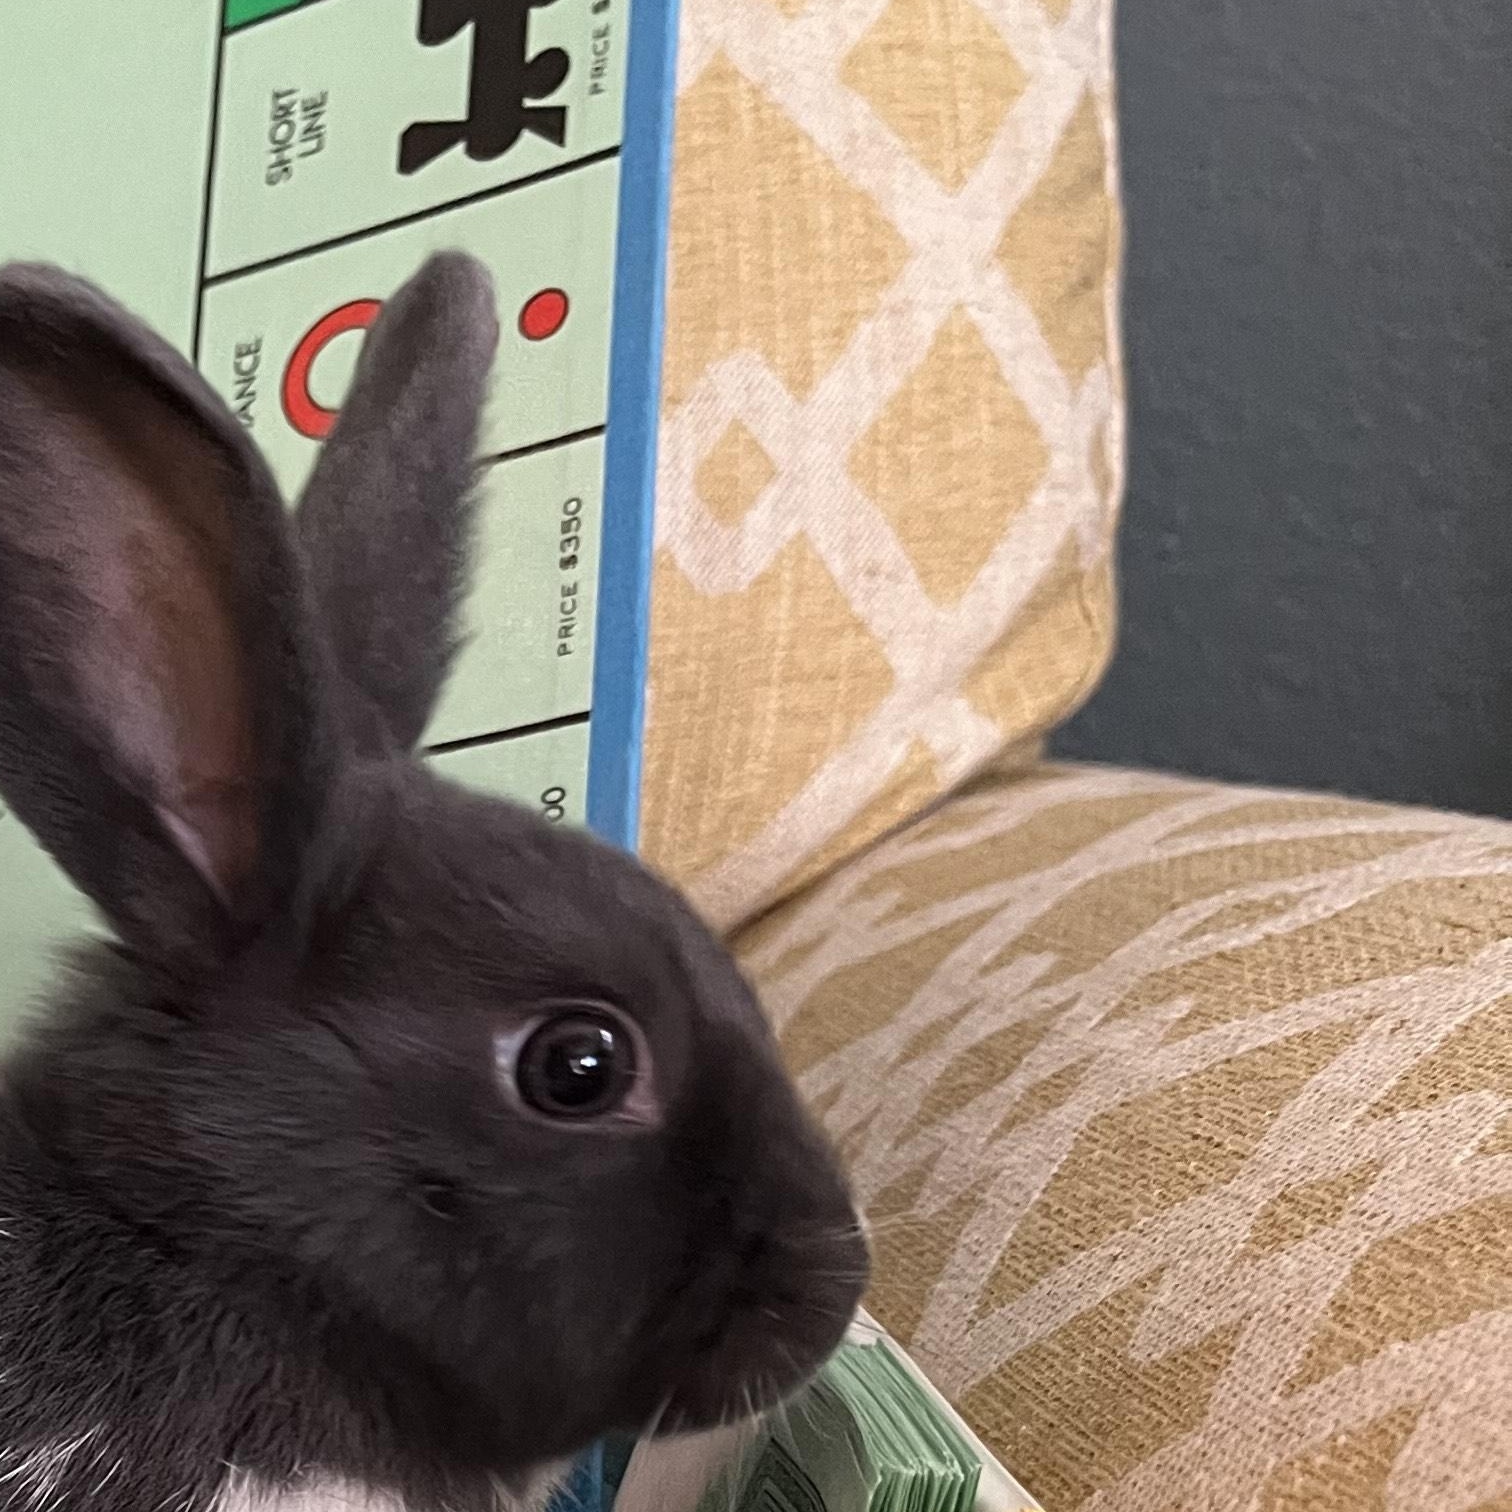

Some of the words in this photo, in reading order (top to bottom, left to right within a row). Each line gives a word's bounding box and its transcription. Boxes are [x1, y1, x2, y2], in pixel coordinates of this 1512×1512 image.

[589, 23, 611, 95] PRICE
[265, 88, 300, 186] SHORT
[297, 90, 328, 158] LINE
[233, 336, 263, 428] ANCE
[559, 497, 582, 571] $350
[557, 582, 578, 657] PRICE
